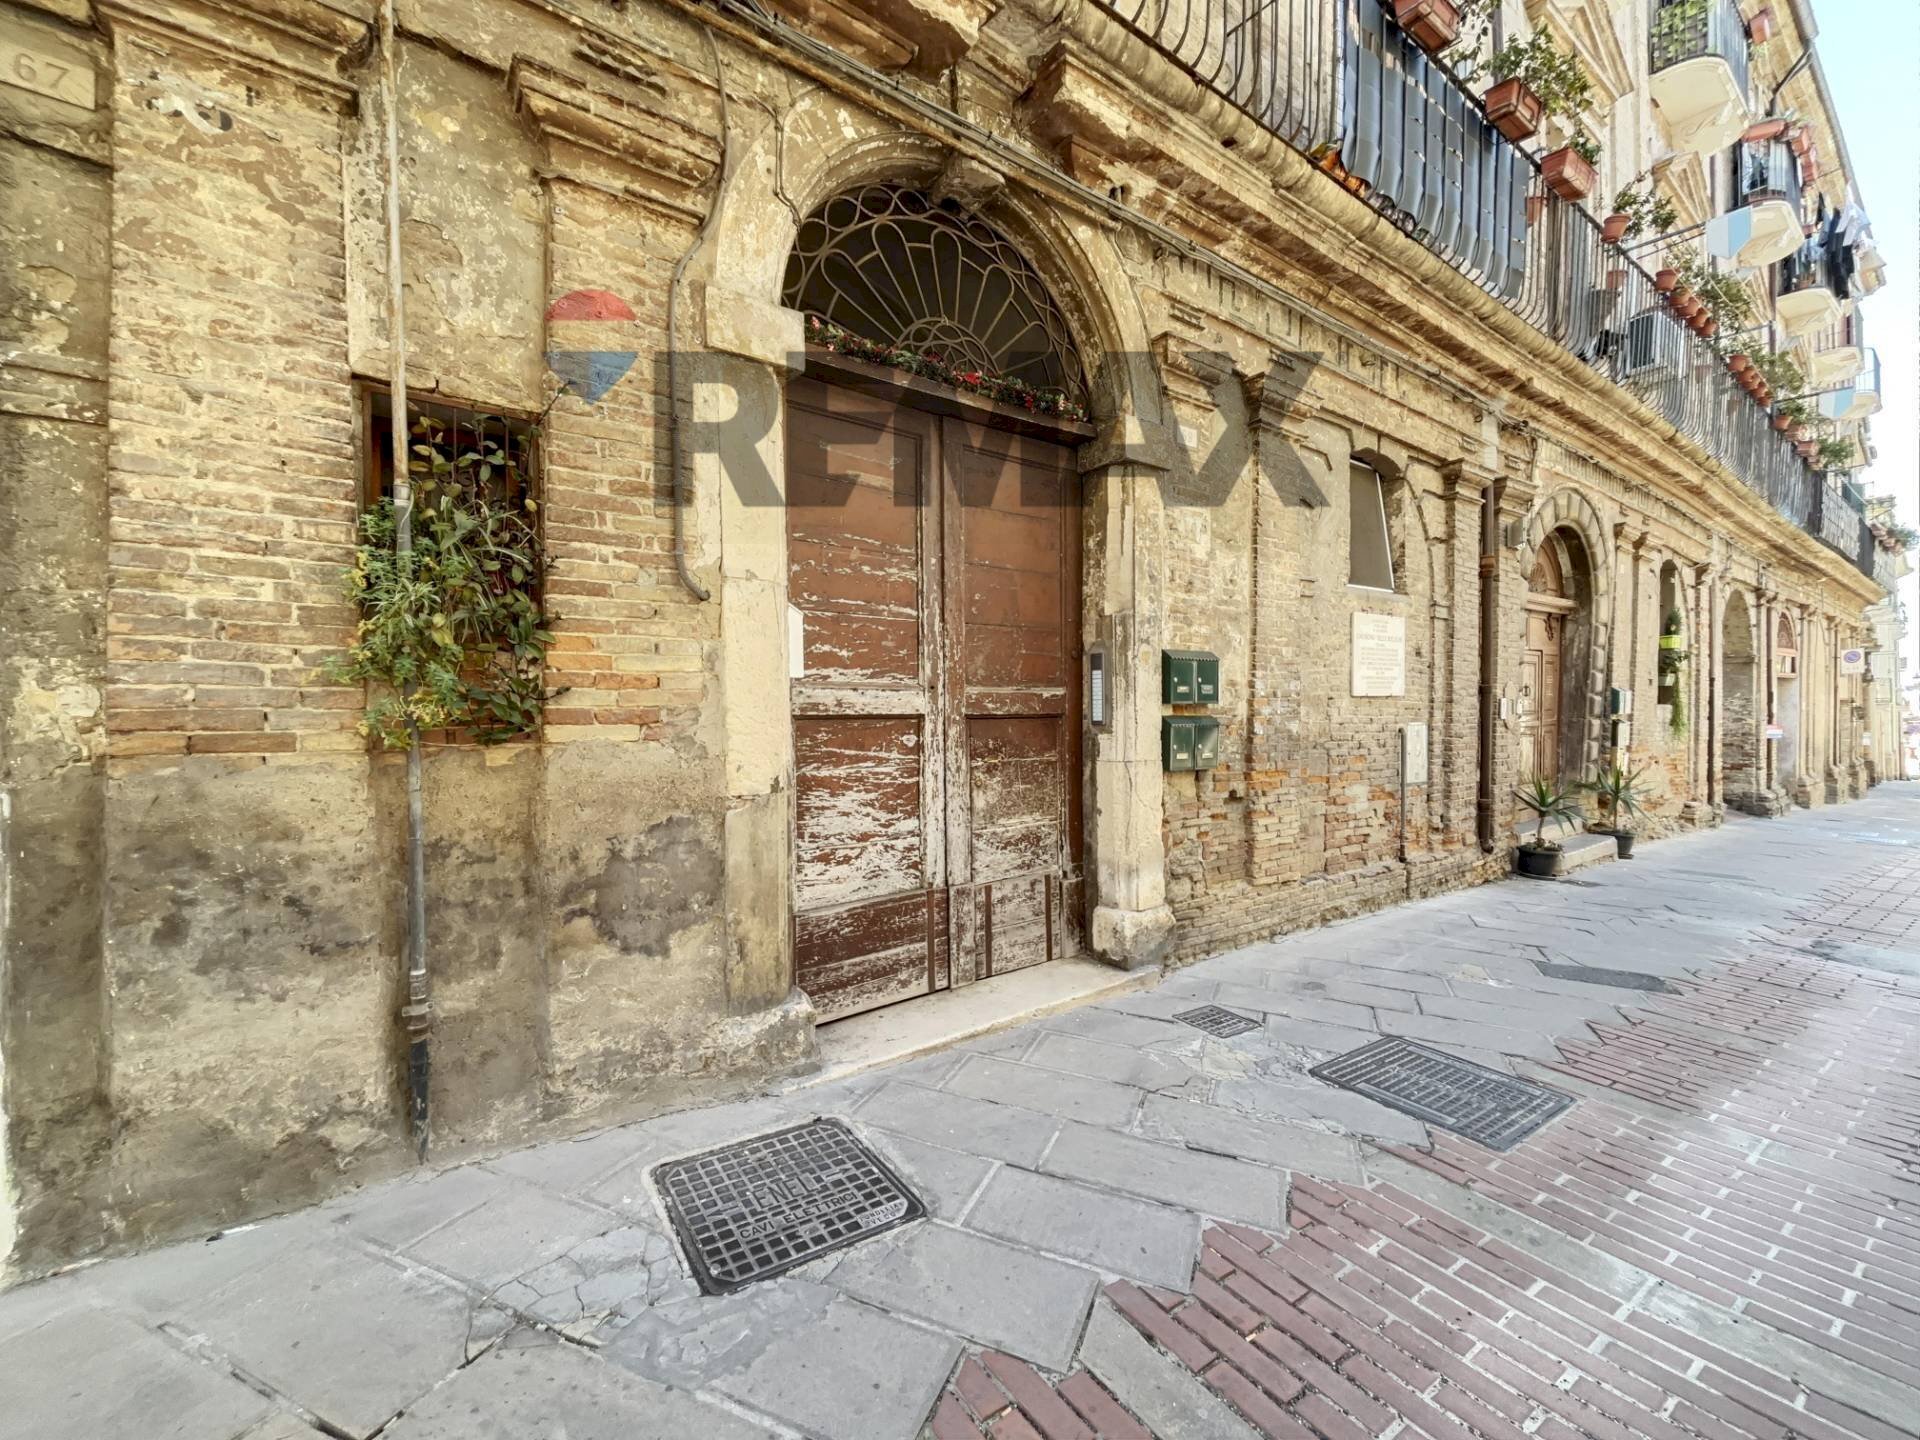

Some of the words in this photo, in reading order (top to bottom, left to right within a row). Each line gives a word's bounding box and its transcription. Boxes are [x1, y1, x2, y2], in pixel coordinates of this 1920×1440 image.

[14, 53, 70, 89] 67
[750, 1175, 820, 1209] ENEL
[739, 1220, 775, 1239] CAVI
[783, 1191, 858, 1224] ELETTRICI
